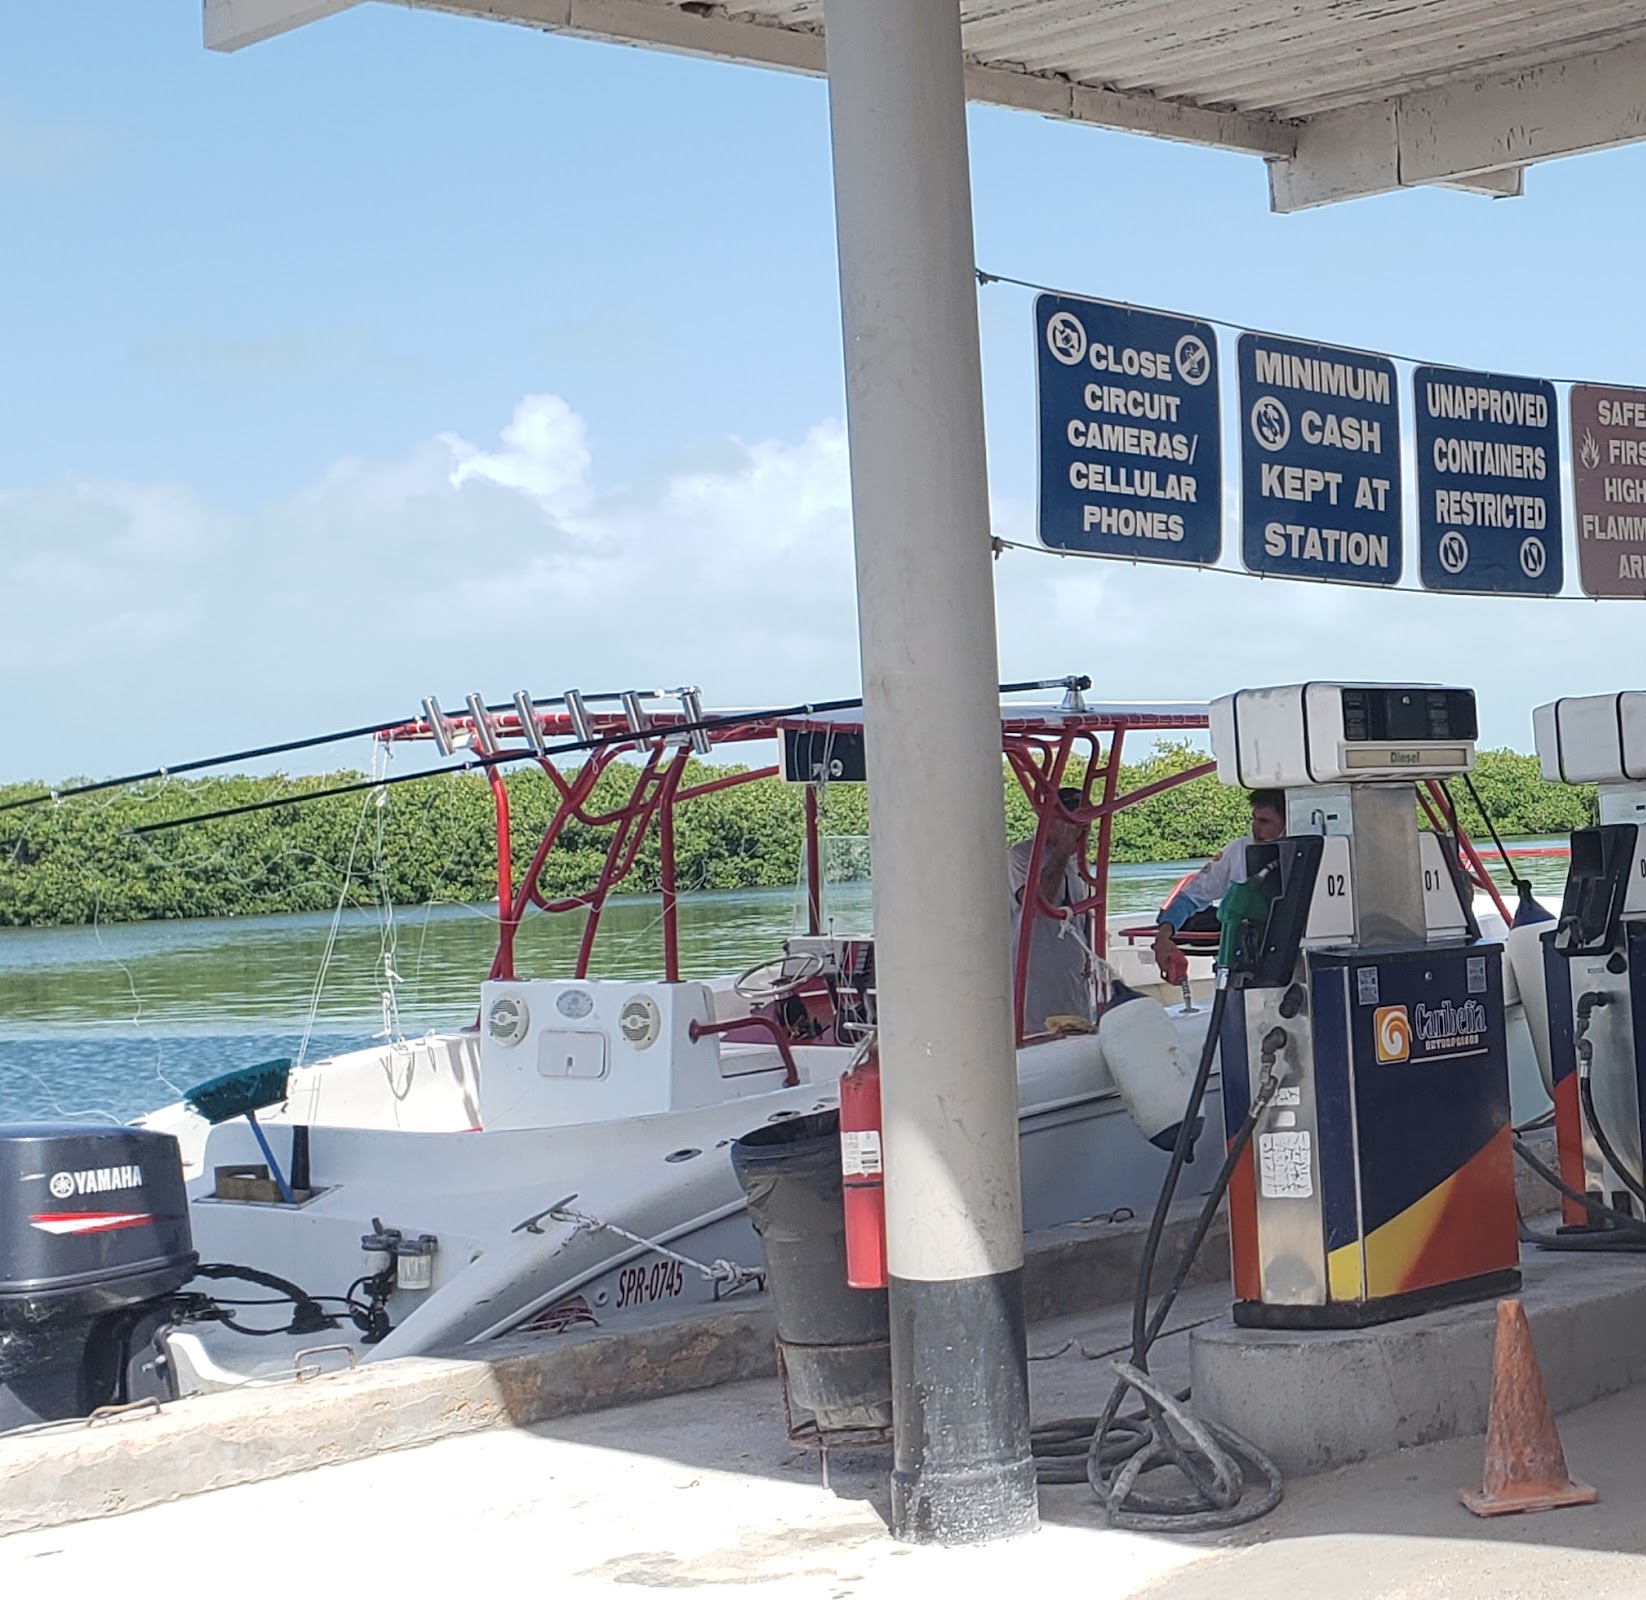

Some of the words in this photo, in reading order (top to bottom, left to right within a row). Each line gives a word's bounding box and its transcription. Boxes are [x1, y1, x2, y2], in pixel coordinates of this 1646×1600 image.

[1089, 343, 1172, 381] CLOSE
[1255, 350, 1390, 405] MINIMUM
[1084, 384, 1181, 422] CIRCUIT
[1427, 382, 1548, 428] UNAPPROVED
[1067, 420, 1198, 464] CAMERAS/
[1301, 411, 1381, 454] CASH
[1434, 438, 1546, 480] CONTAINERS
[1069, 462, 1197, 503] CELLULAR
[1261, 463, 1342, 505] KEPT
[1354, 478, 1390, 511] AT
[1083, 505, 1185, 541] PHONES
[1436, 490, 1546, 530] RESTRICTED
[1265, 522, 1388, 568] STATION
[1390, 752, 1420, 763] Diesel
[1327, 874, 1345, 896] 02
[1425, 869, 1440, 891] 01
[1415, 1000, 1487, 1040] Caribeña
[74, 1165, 142, 1194] YAMAHA
[616, 1260, 683, 1308] SPR-0745
